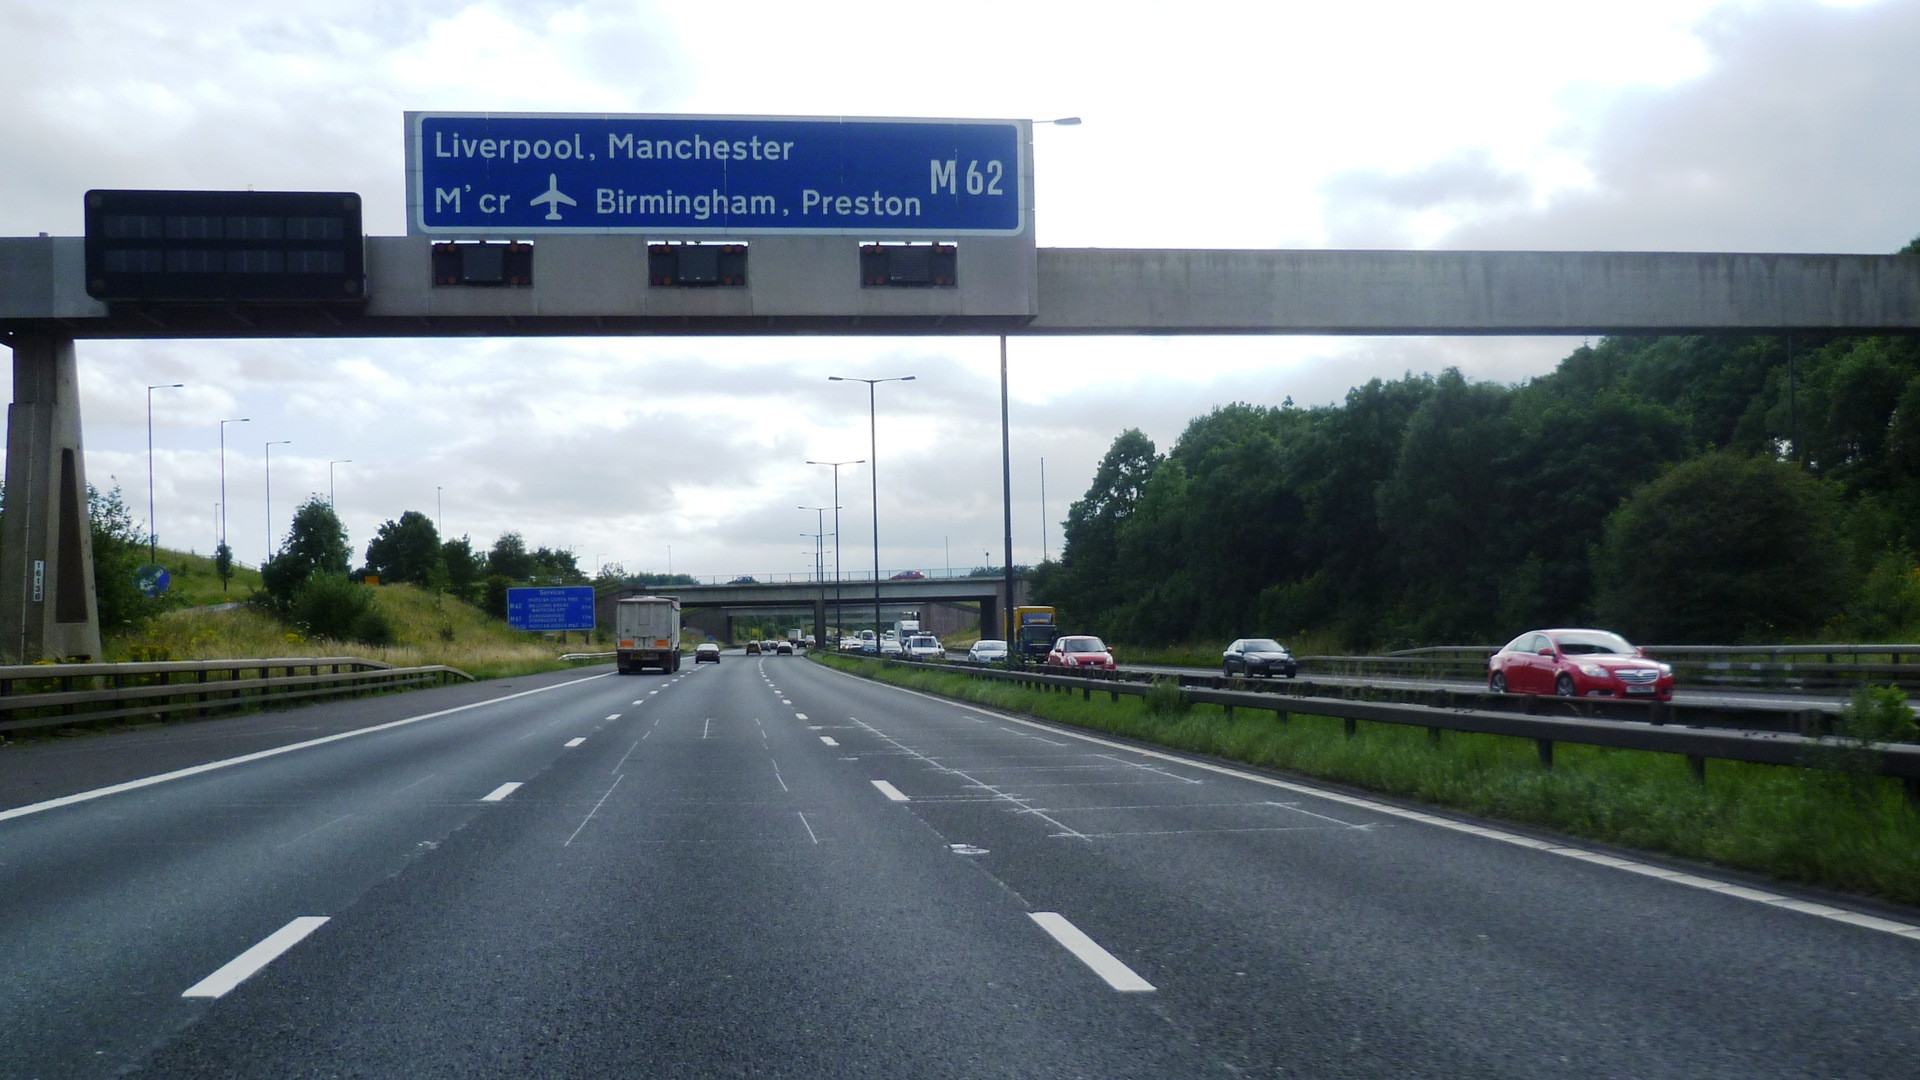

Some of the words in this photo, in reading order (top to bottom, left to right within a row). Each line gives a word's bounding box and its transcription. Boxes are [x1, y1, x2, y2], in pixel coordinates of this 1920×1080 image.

[436, 131, 595, 163] Liverpool,
[608, 133, 794, 161] Manchester
[596, 188, 789, 220] Birmingham,
[803, 189, 921, 216] Preston
